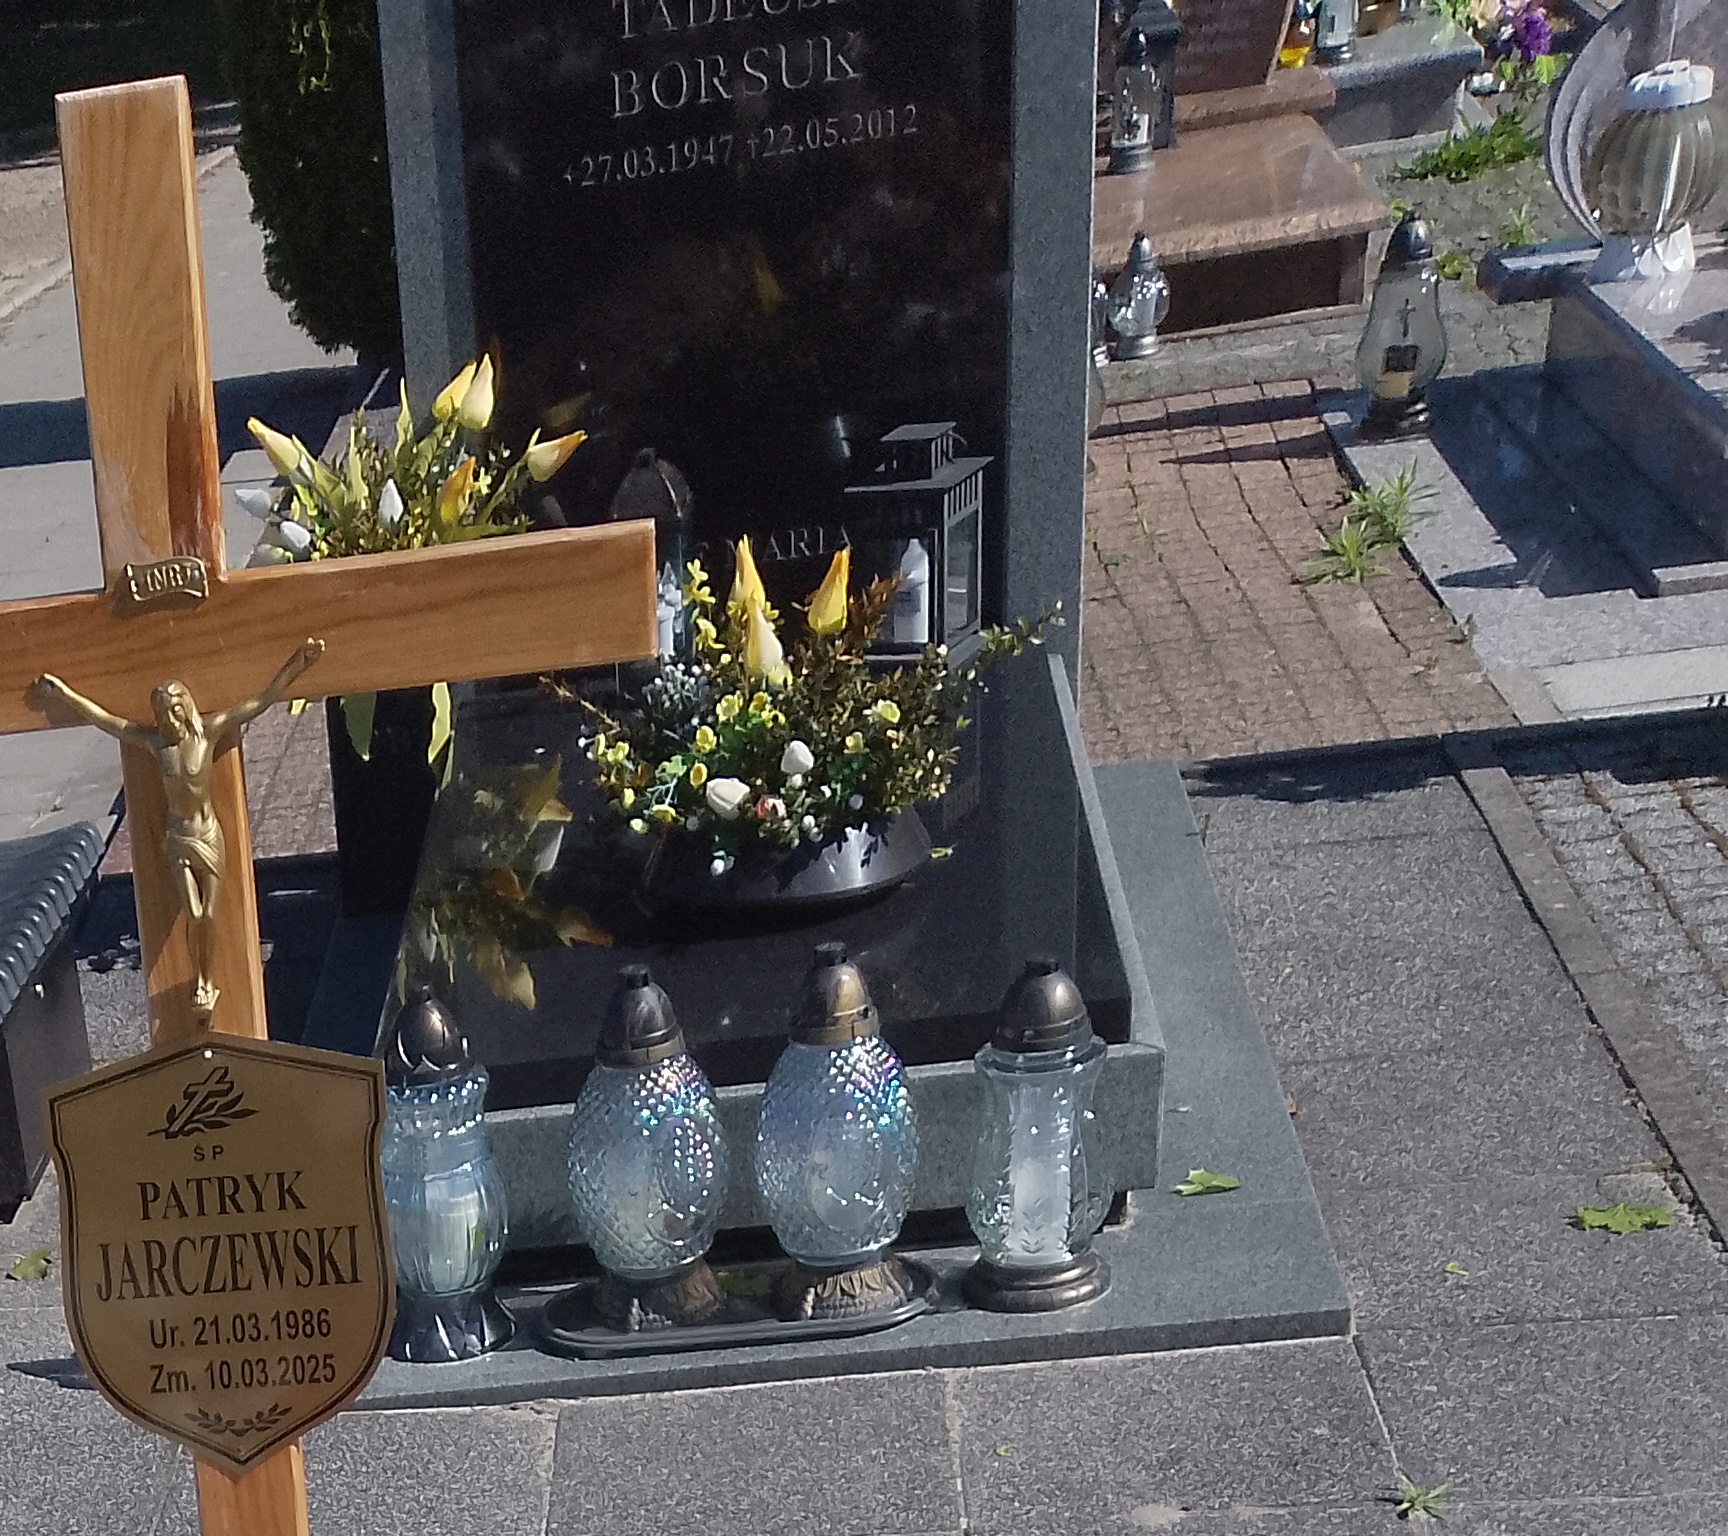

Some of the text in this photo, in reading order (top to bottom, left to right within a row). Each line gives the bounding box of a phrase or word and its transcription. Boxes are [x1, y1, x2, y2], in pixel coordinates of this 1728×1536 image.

[610, 0, 838, 39] TADE
[610, 31, 864, 118] BORSUK
[146, 563, 191, 592] INRI
[136, 1170, 308, 1221] PATRYK
[95, 1224, 363, 1302] JARCZEWSKI
[148, 1307, 332, 1349] Ur. 21.03.1986
[149, 1352, 337, 1394] Zm. 10.03.2025
